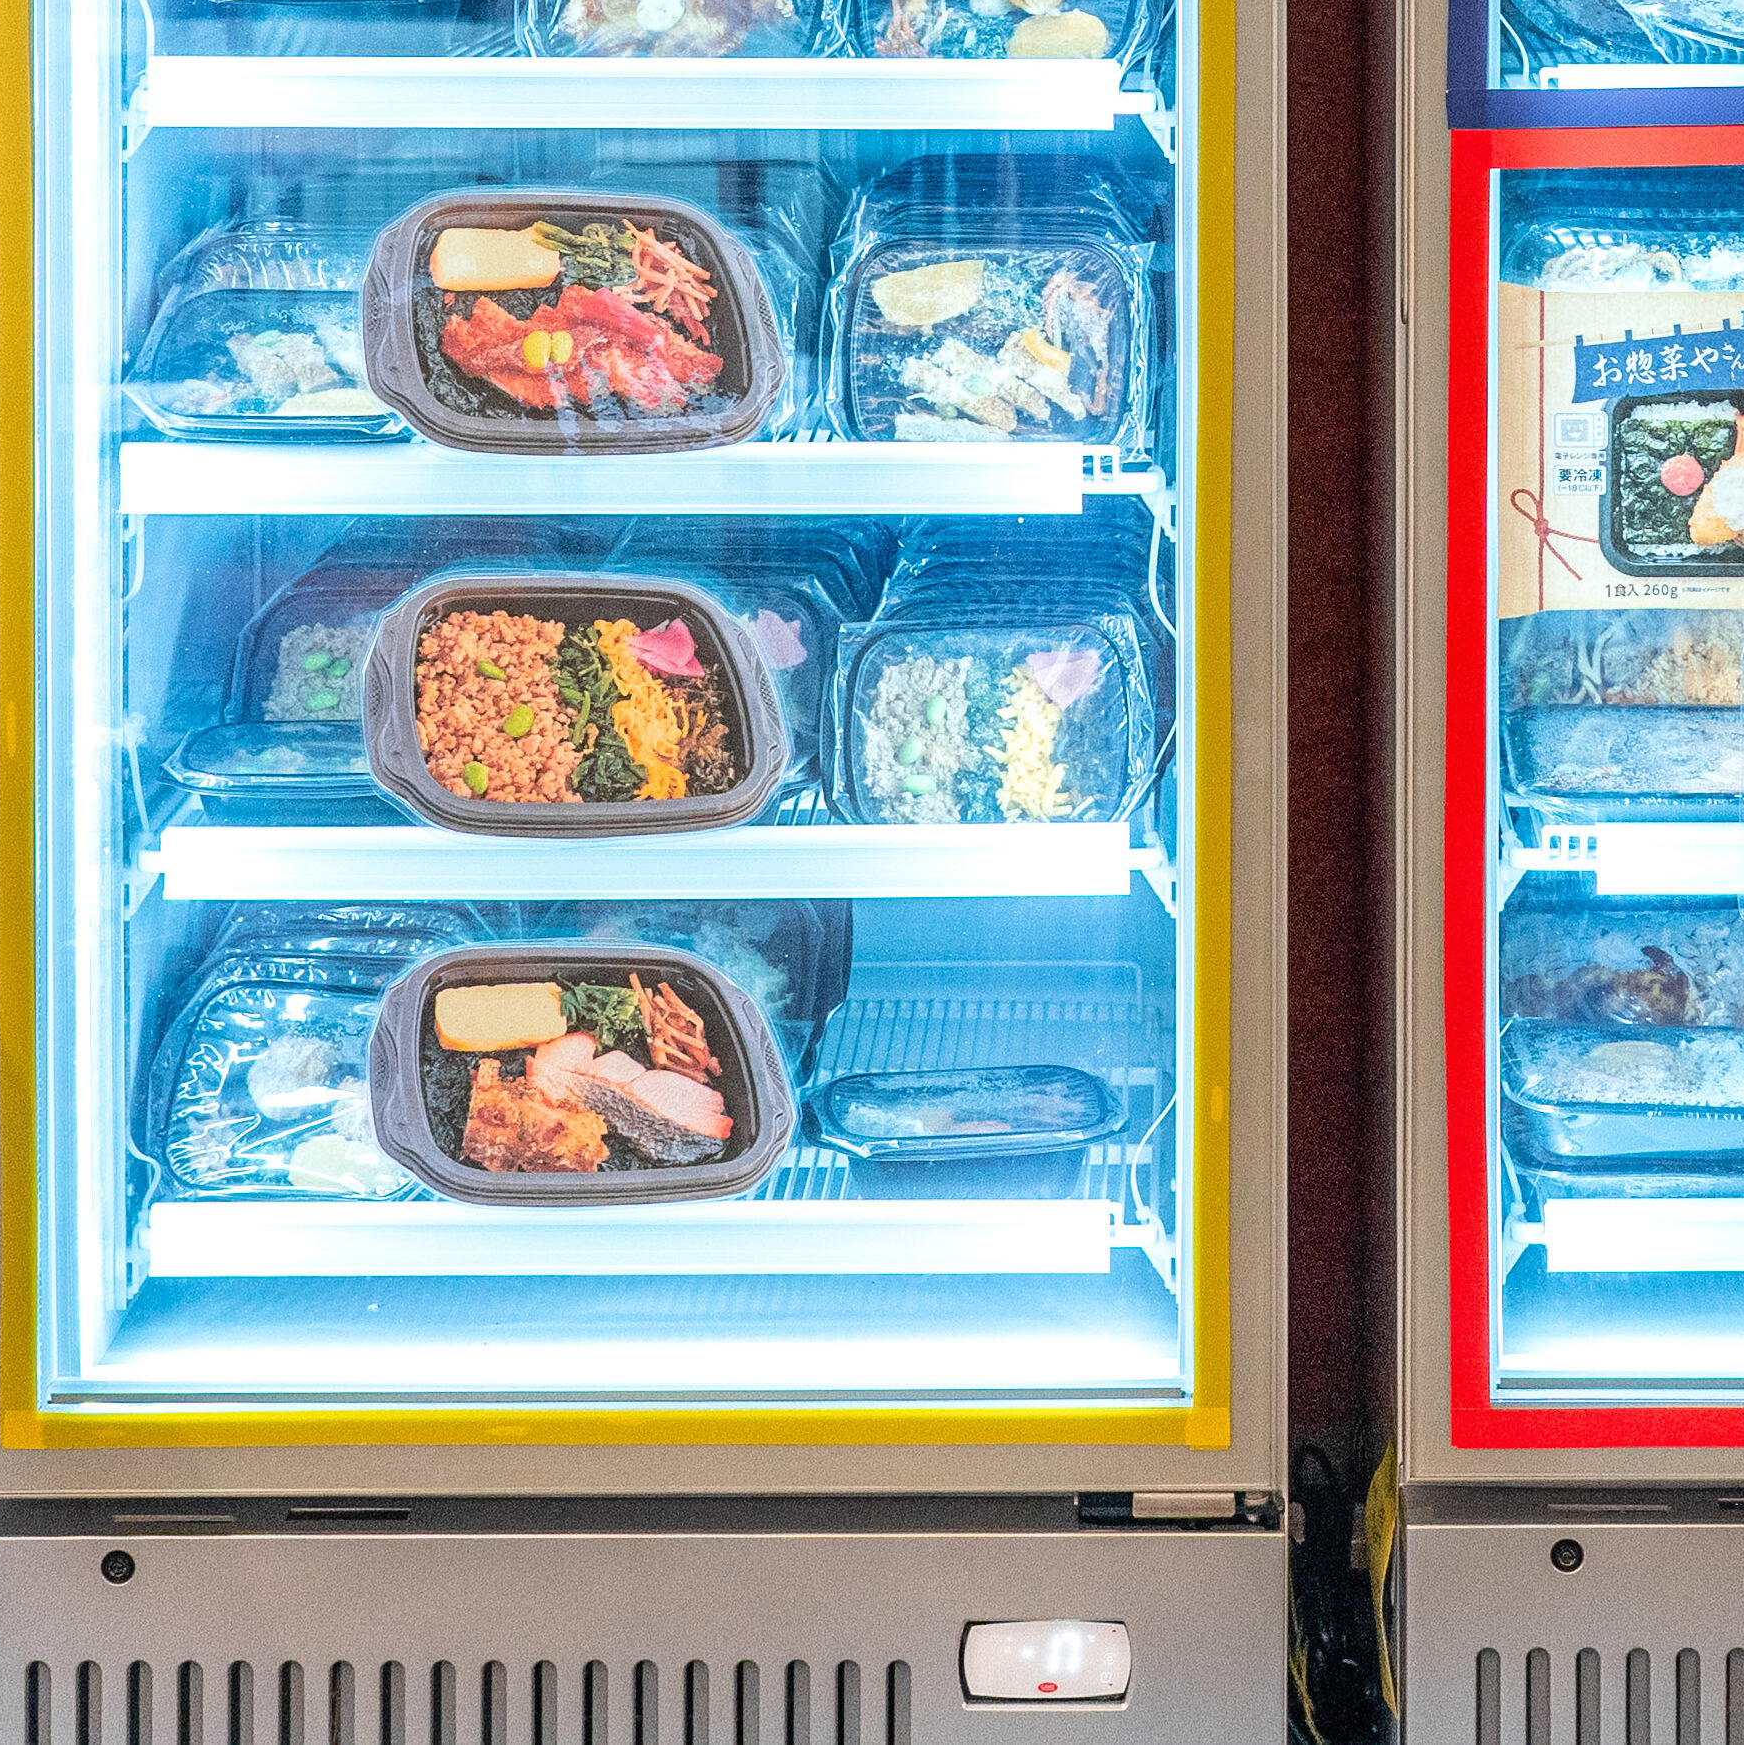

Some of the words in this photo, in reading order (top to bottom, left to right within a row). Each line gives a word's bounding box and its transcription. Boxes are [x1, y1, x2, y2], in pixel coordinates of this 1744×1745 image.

[1558, 467, 1604, 482] 要冷凍
[1644, 583, 1679, 599] 260g
